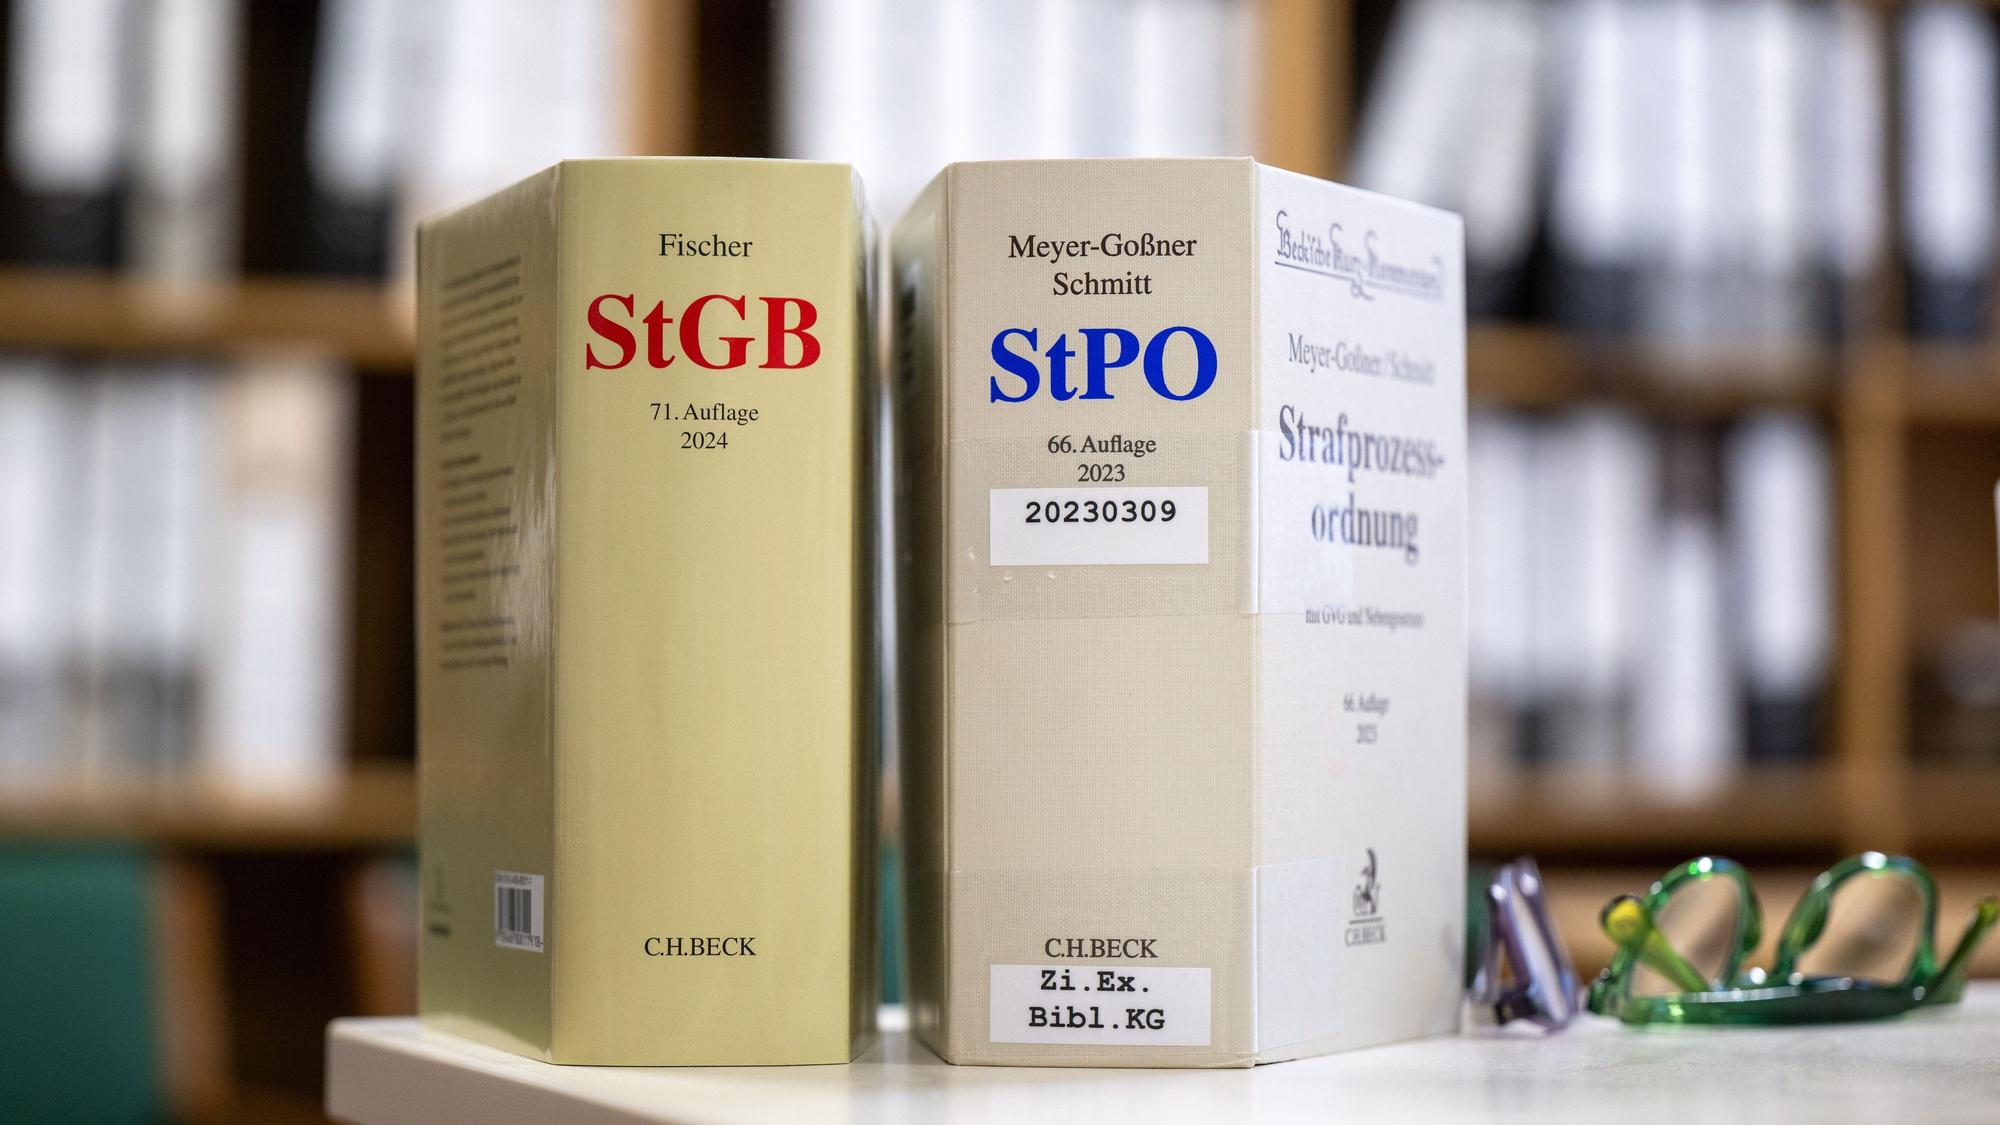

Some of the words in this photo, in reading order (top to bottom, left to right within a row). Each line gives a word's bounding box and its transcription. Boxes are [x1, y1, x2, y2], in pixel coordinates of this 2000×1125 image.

[658, 232, 754, 258] Fischer
[1008, 232, 1198, 264] Meyer-Goßner
[1052, 270, 1153, 296] Schmitt
[585, 293, 822, 371] StGB
[989, 326, 1219, 404] StPO
[649, 403, 679, 421] 71.
[682, 403, 759, 425] Auflage
[680, 431, 729, 450] 2024
[1047, 435, 1077, 454] 66.
[1079, 434, 1157, 458] Auflage
[1279, 404, 1444, 484] Strafprozess-
[1077, 463, 1126, 483] 2023
[1025, 499, 1177, 524] 20230309
[1311, 491, 1420, 566] ordnung
[644, 936, 757, 957] C.H.BECK
[1044, 937, 1159, 959] C.H.BECK
[1040, 969, 1149, 993] Zi.Ex.
[1028, 1005, 1166, 1031] Bibl.KG
